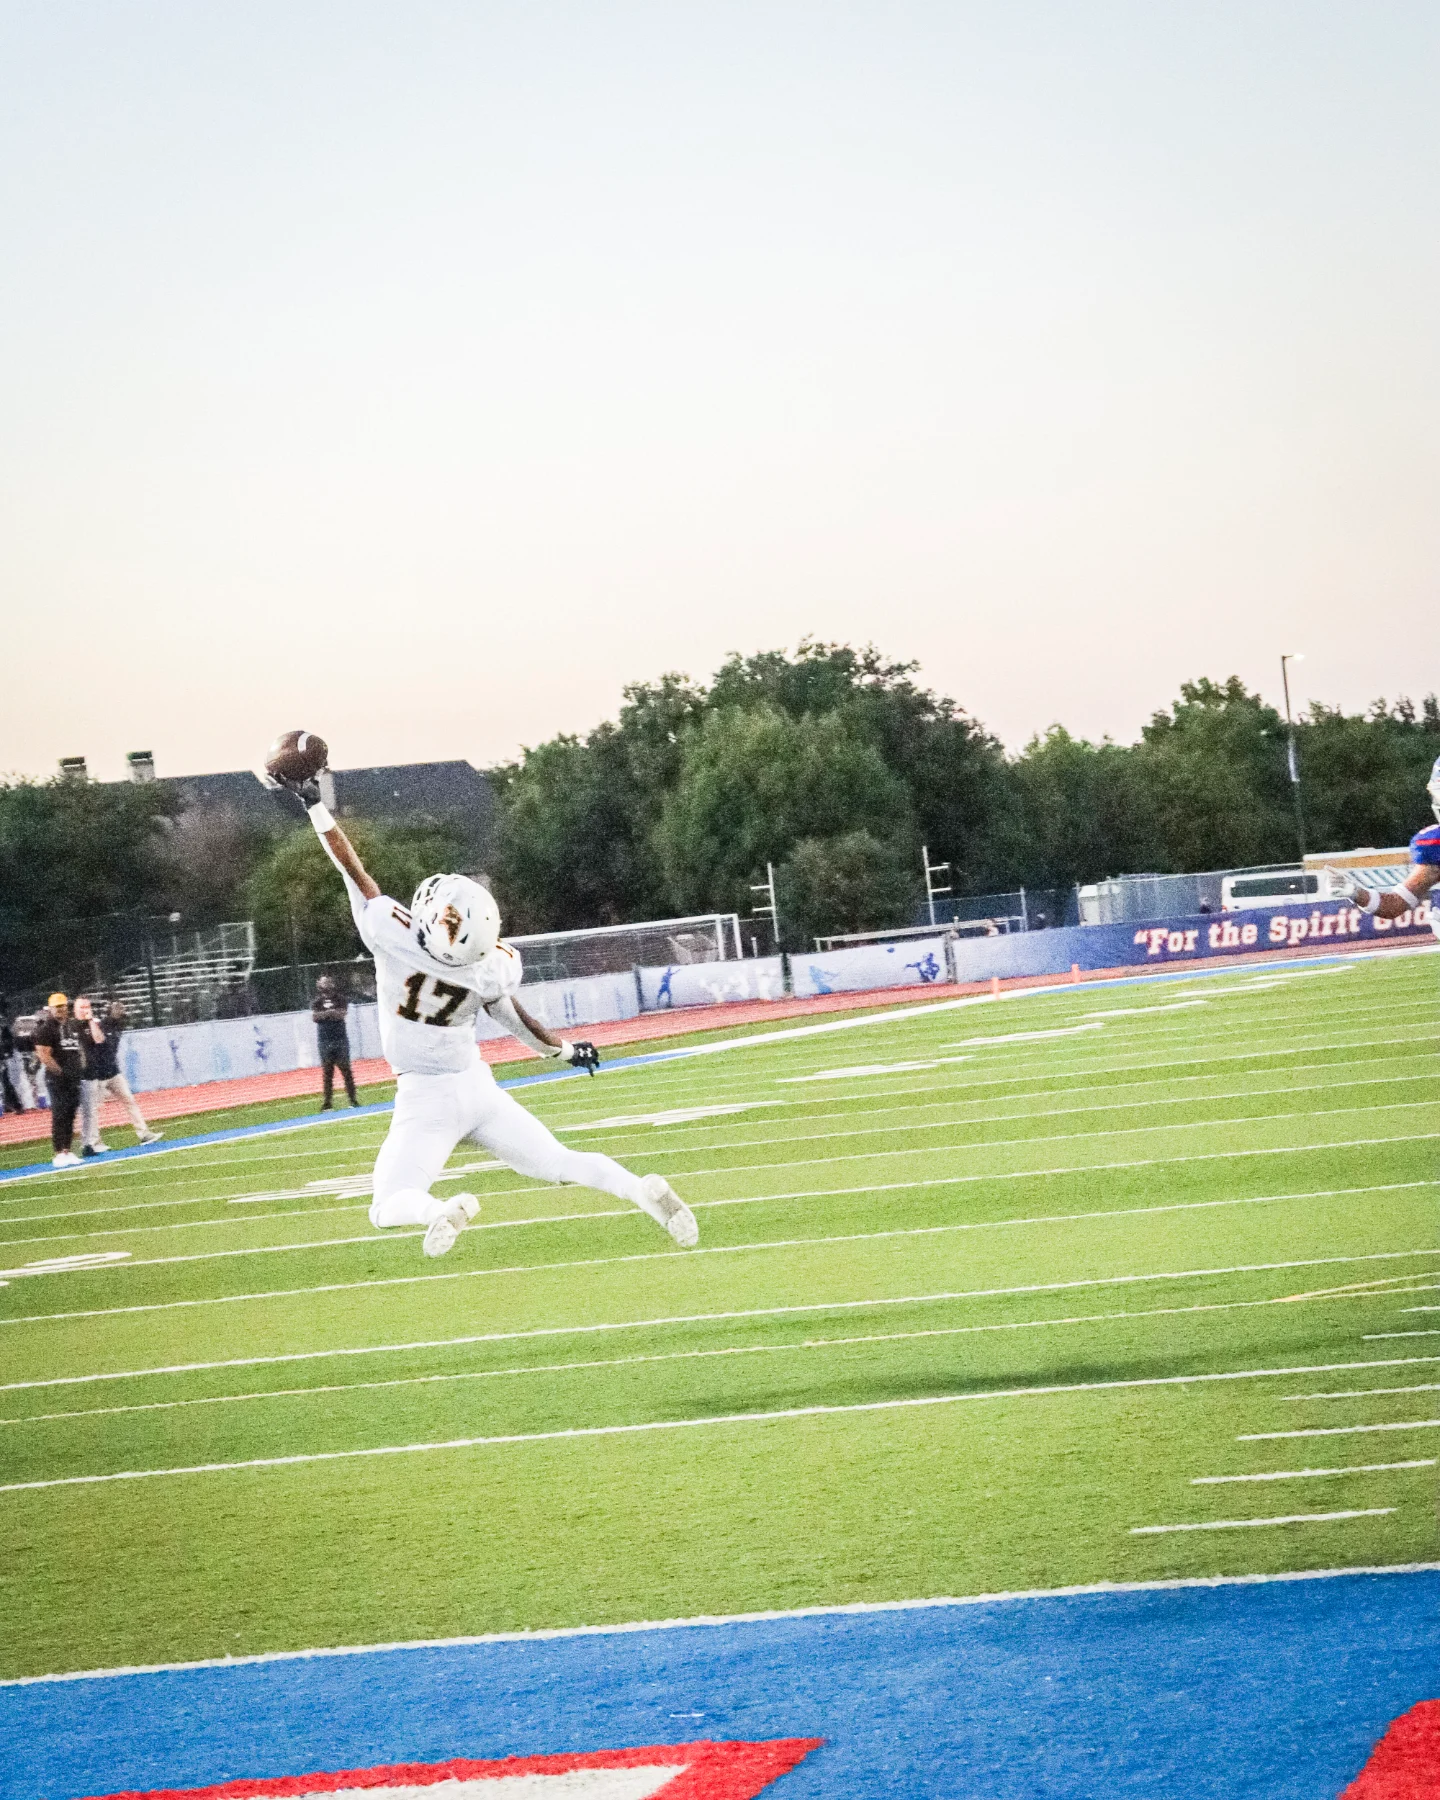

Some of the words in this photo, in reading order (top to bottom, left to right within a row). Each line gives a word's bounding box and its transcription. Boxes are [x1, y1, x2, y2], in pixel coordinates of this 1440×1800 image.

[1208, 920, 1258, 948] the
[1269, 907, 1361, 945] Spirit
[396, 971, 471, 1027] 17
